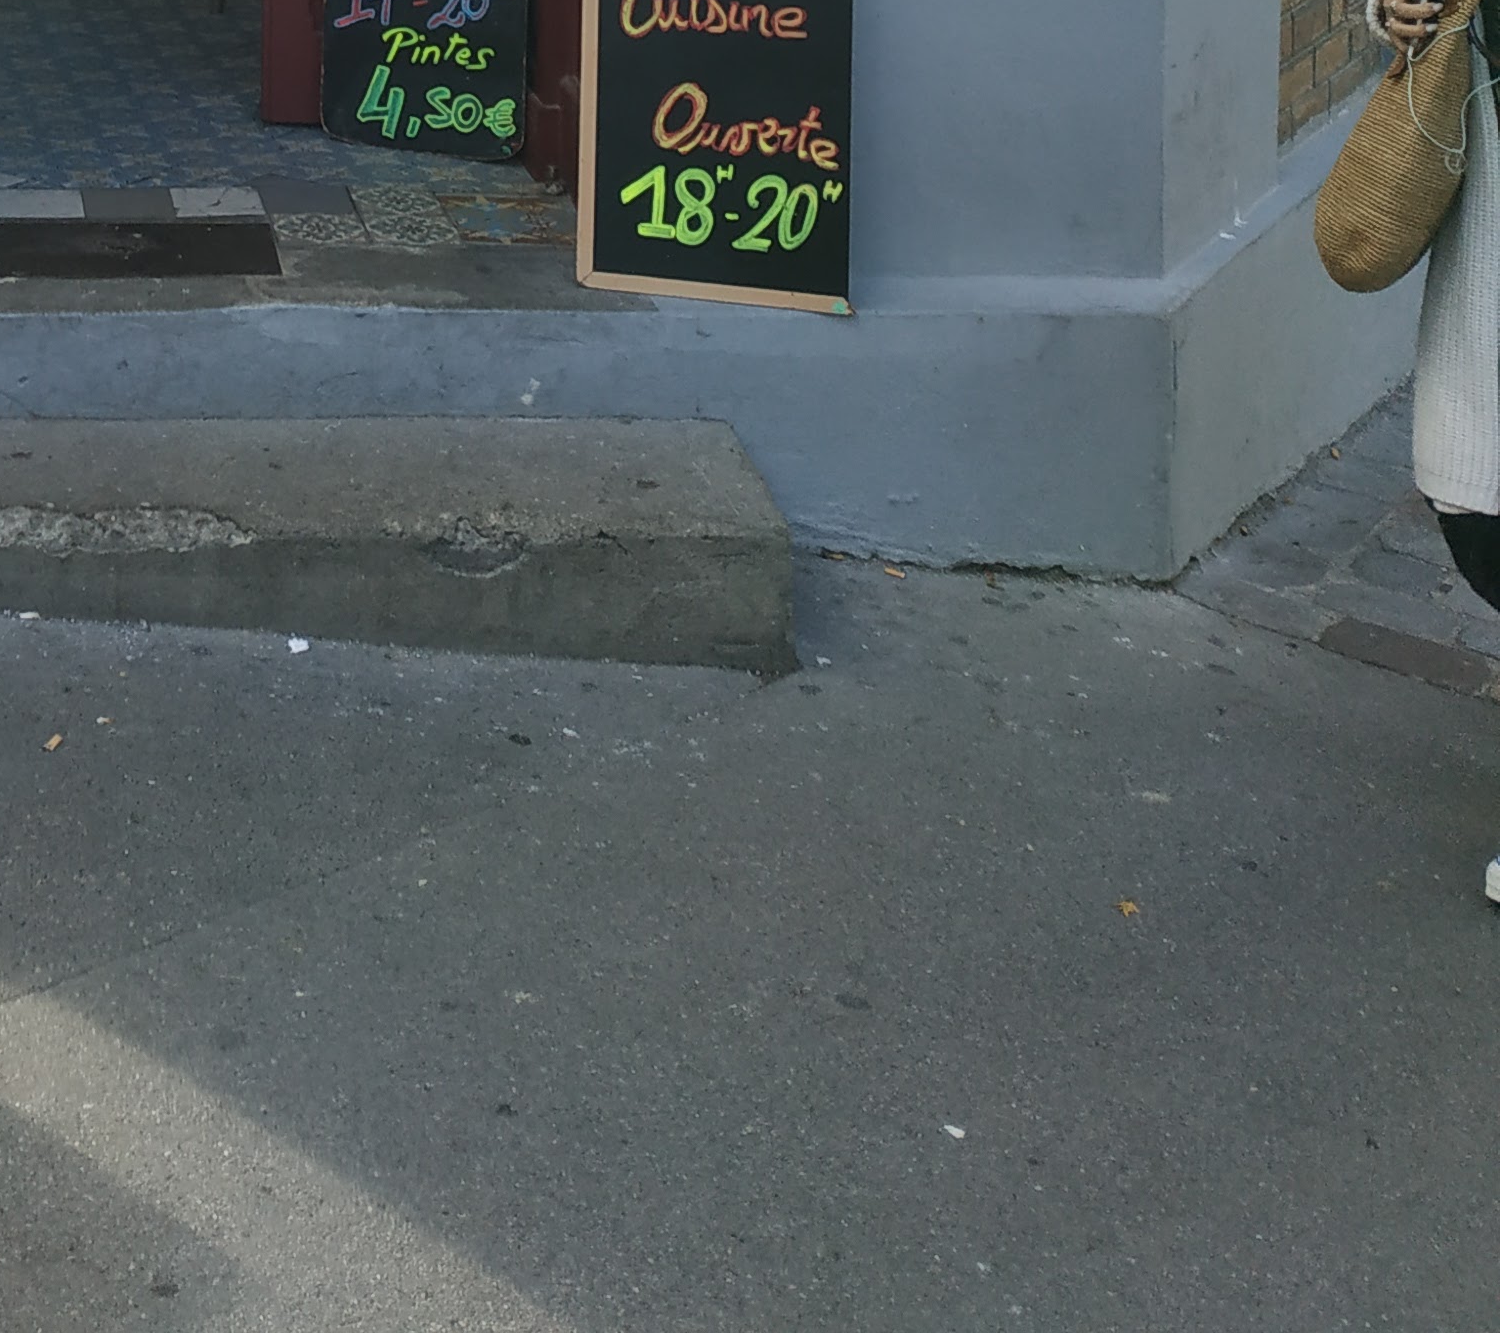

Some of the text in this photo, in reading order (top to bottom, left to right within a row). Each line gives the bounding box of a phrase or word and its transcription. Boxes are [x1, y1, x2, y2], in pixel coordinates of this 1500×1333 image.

[381, 26, 495, 71] Pintes
[356, 64, 517, 140] 4,50€
[651, 82, 842, 172] Ouverte
